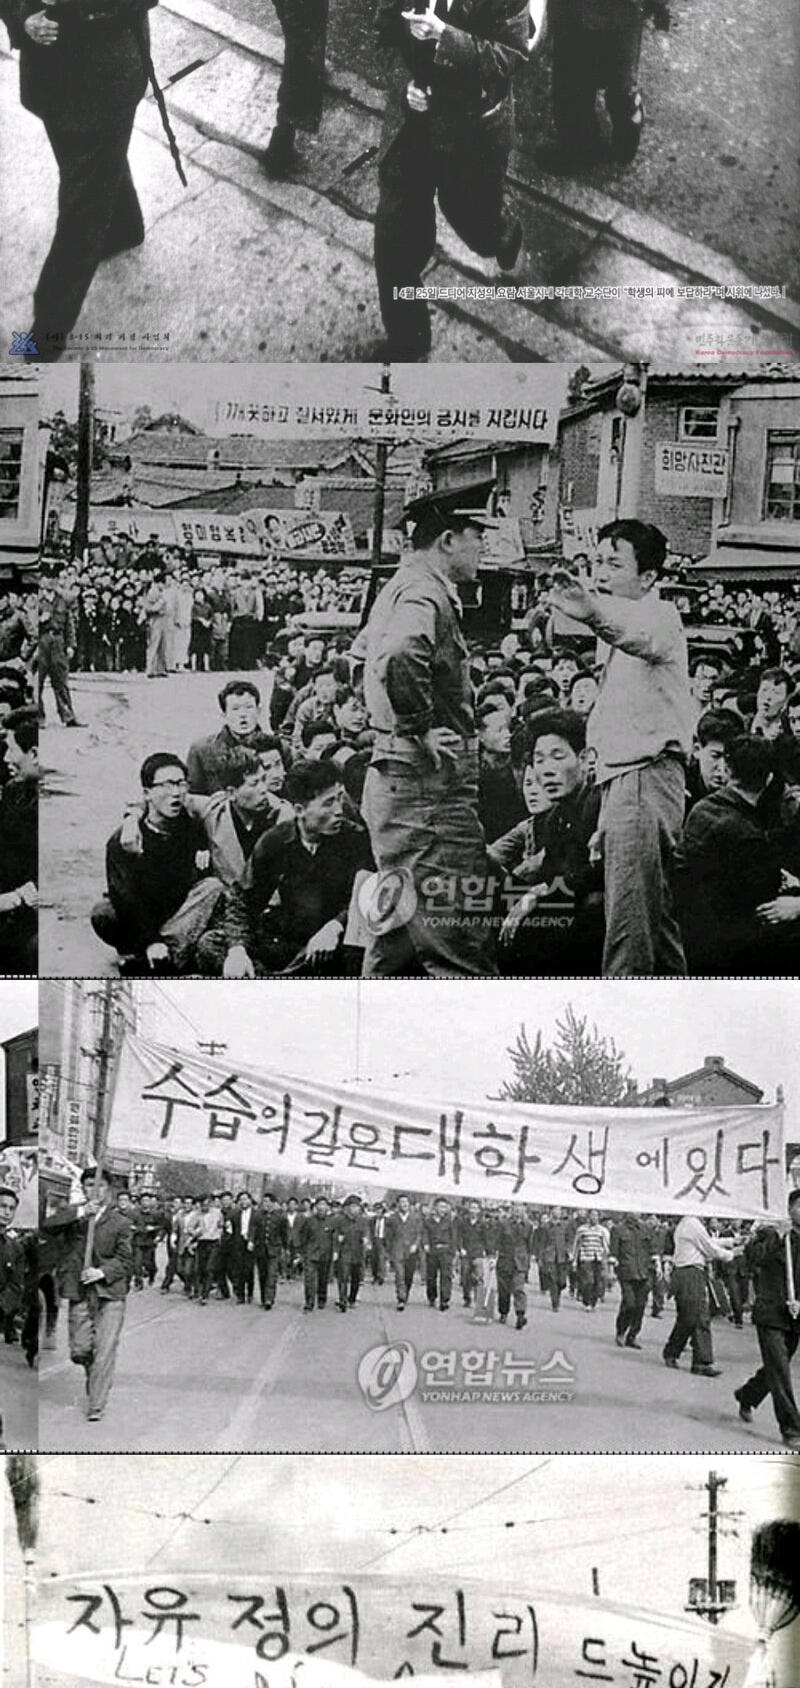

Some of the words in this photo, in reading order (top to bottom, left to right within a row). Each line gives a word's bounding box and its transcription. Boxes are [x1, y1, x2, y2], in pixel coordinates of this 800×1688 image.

[369, 408, 431, 426] 문화인의
[662, 449, 725, 475] 희망사진관
[65, 1584, 201, 1653] 자유
[227, 1584, 360, 1666] 정의
[407, 1588, 538, 1676] 진리
